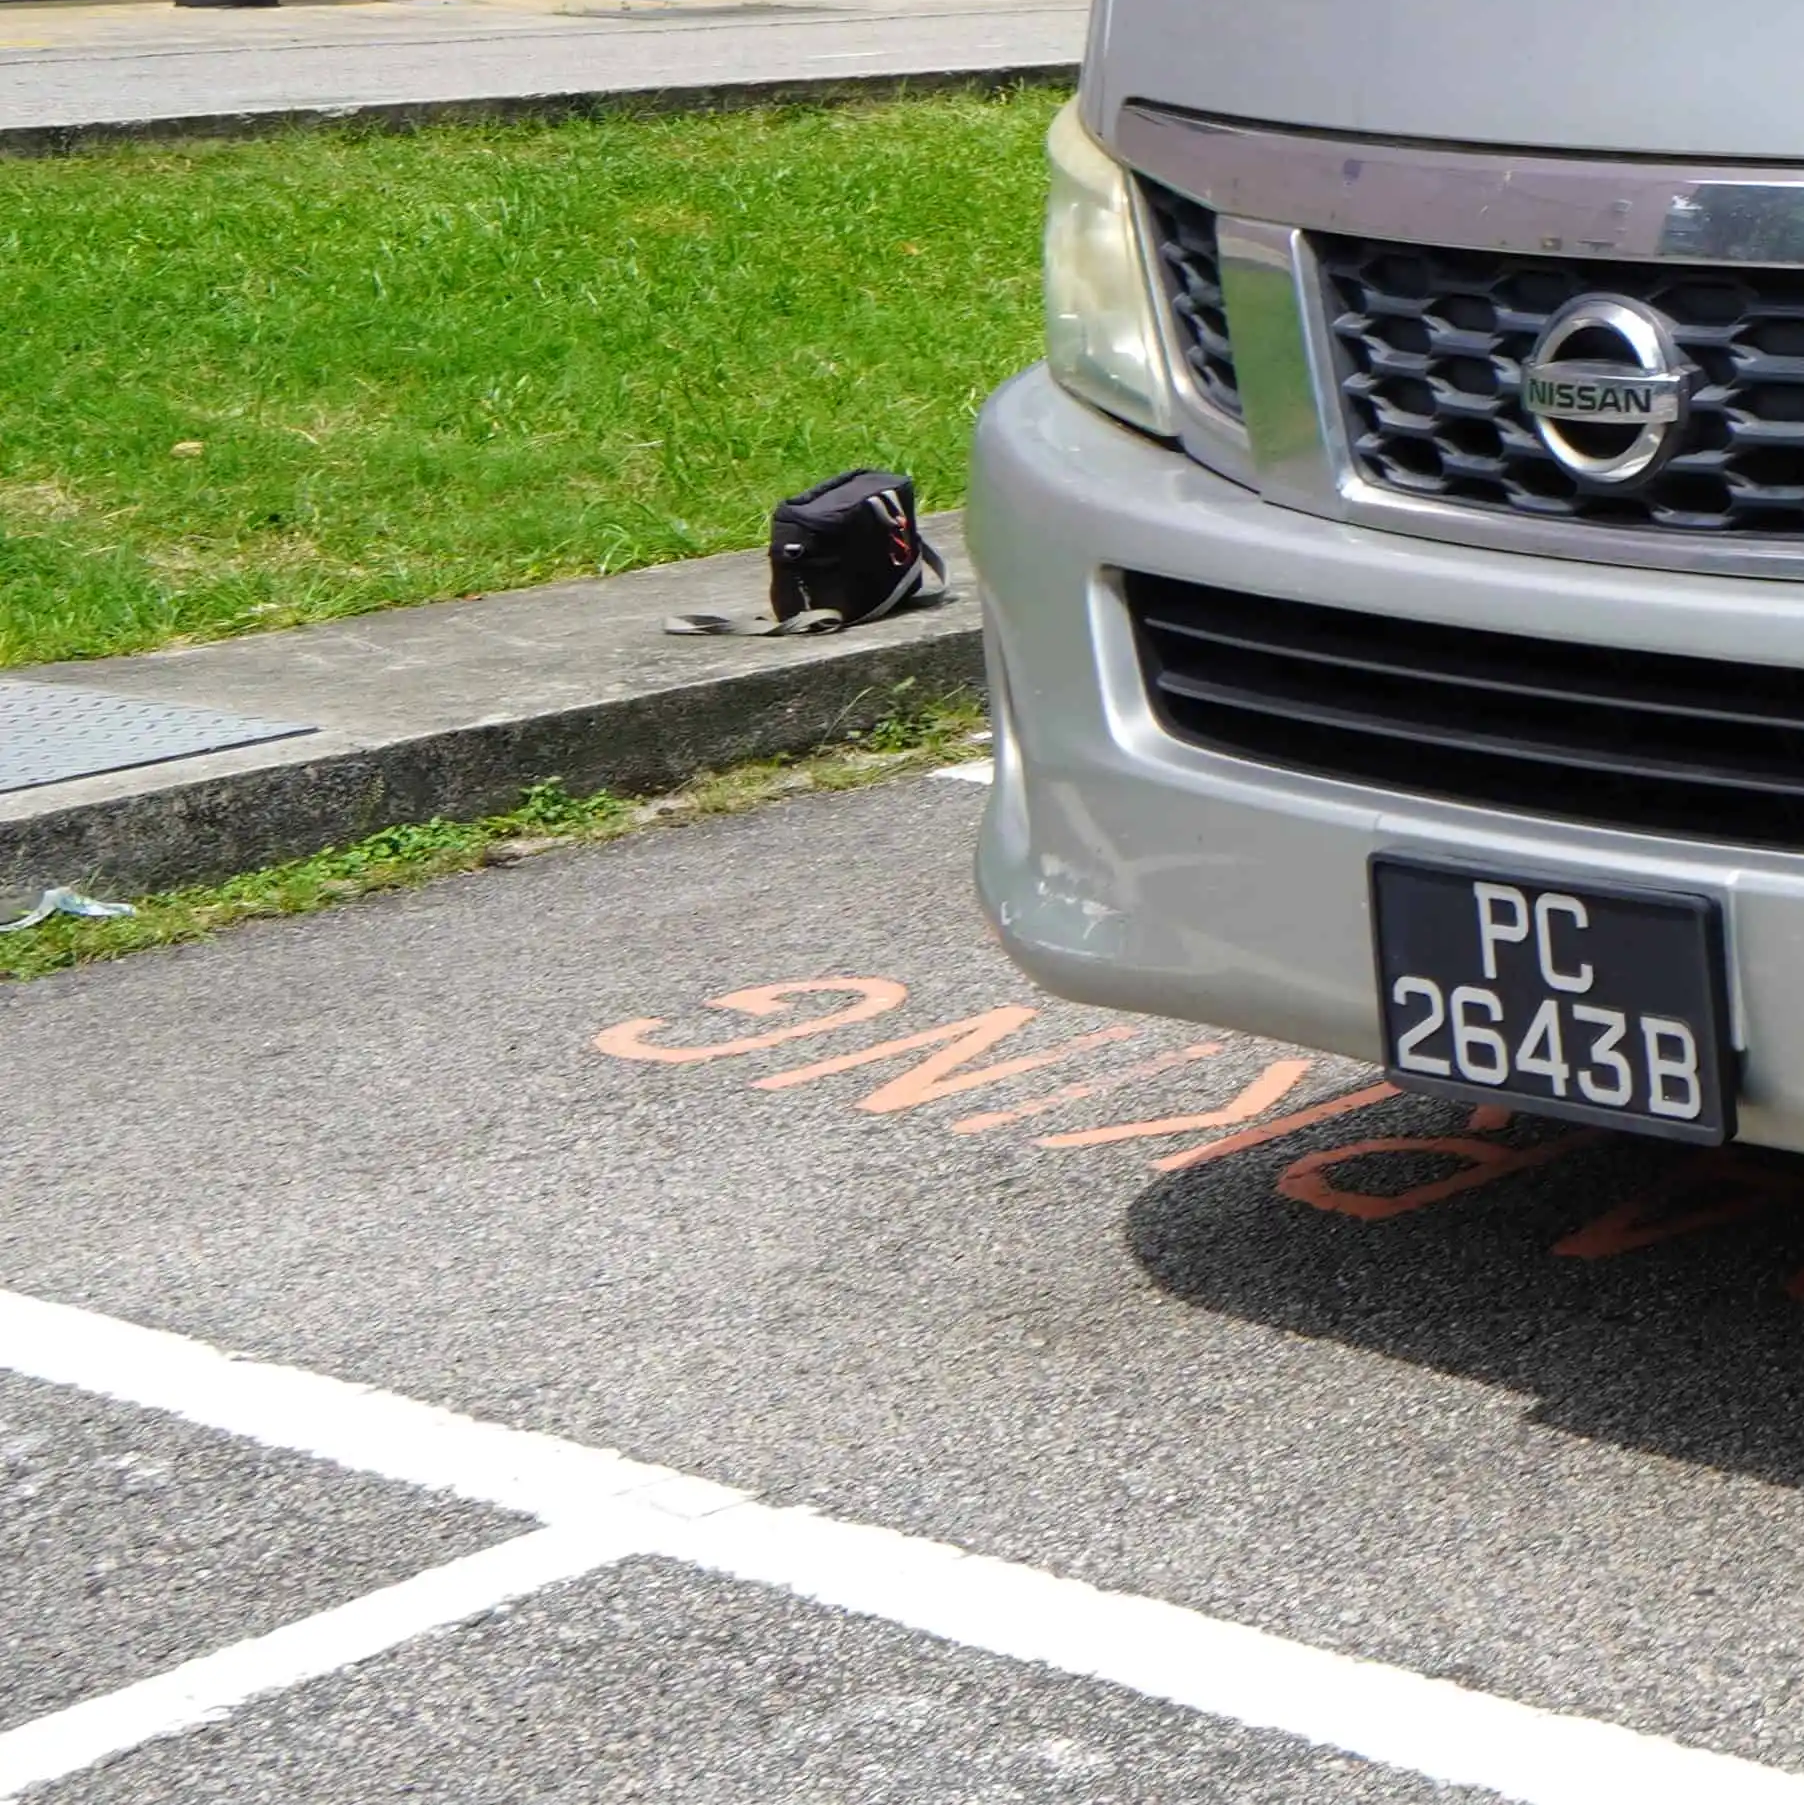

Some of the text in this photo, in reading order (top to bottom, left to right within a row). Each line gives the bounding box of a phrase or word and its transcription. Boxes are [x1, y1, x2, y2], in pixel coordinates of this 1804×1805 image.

[1529, 378, 1652, 413] NISSAN
[1473, 881, 1594, 994] PC
[1393, 974, 1702, 1121] 2643B
